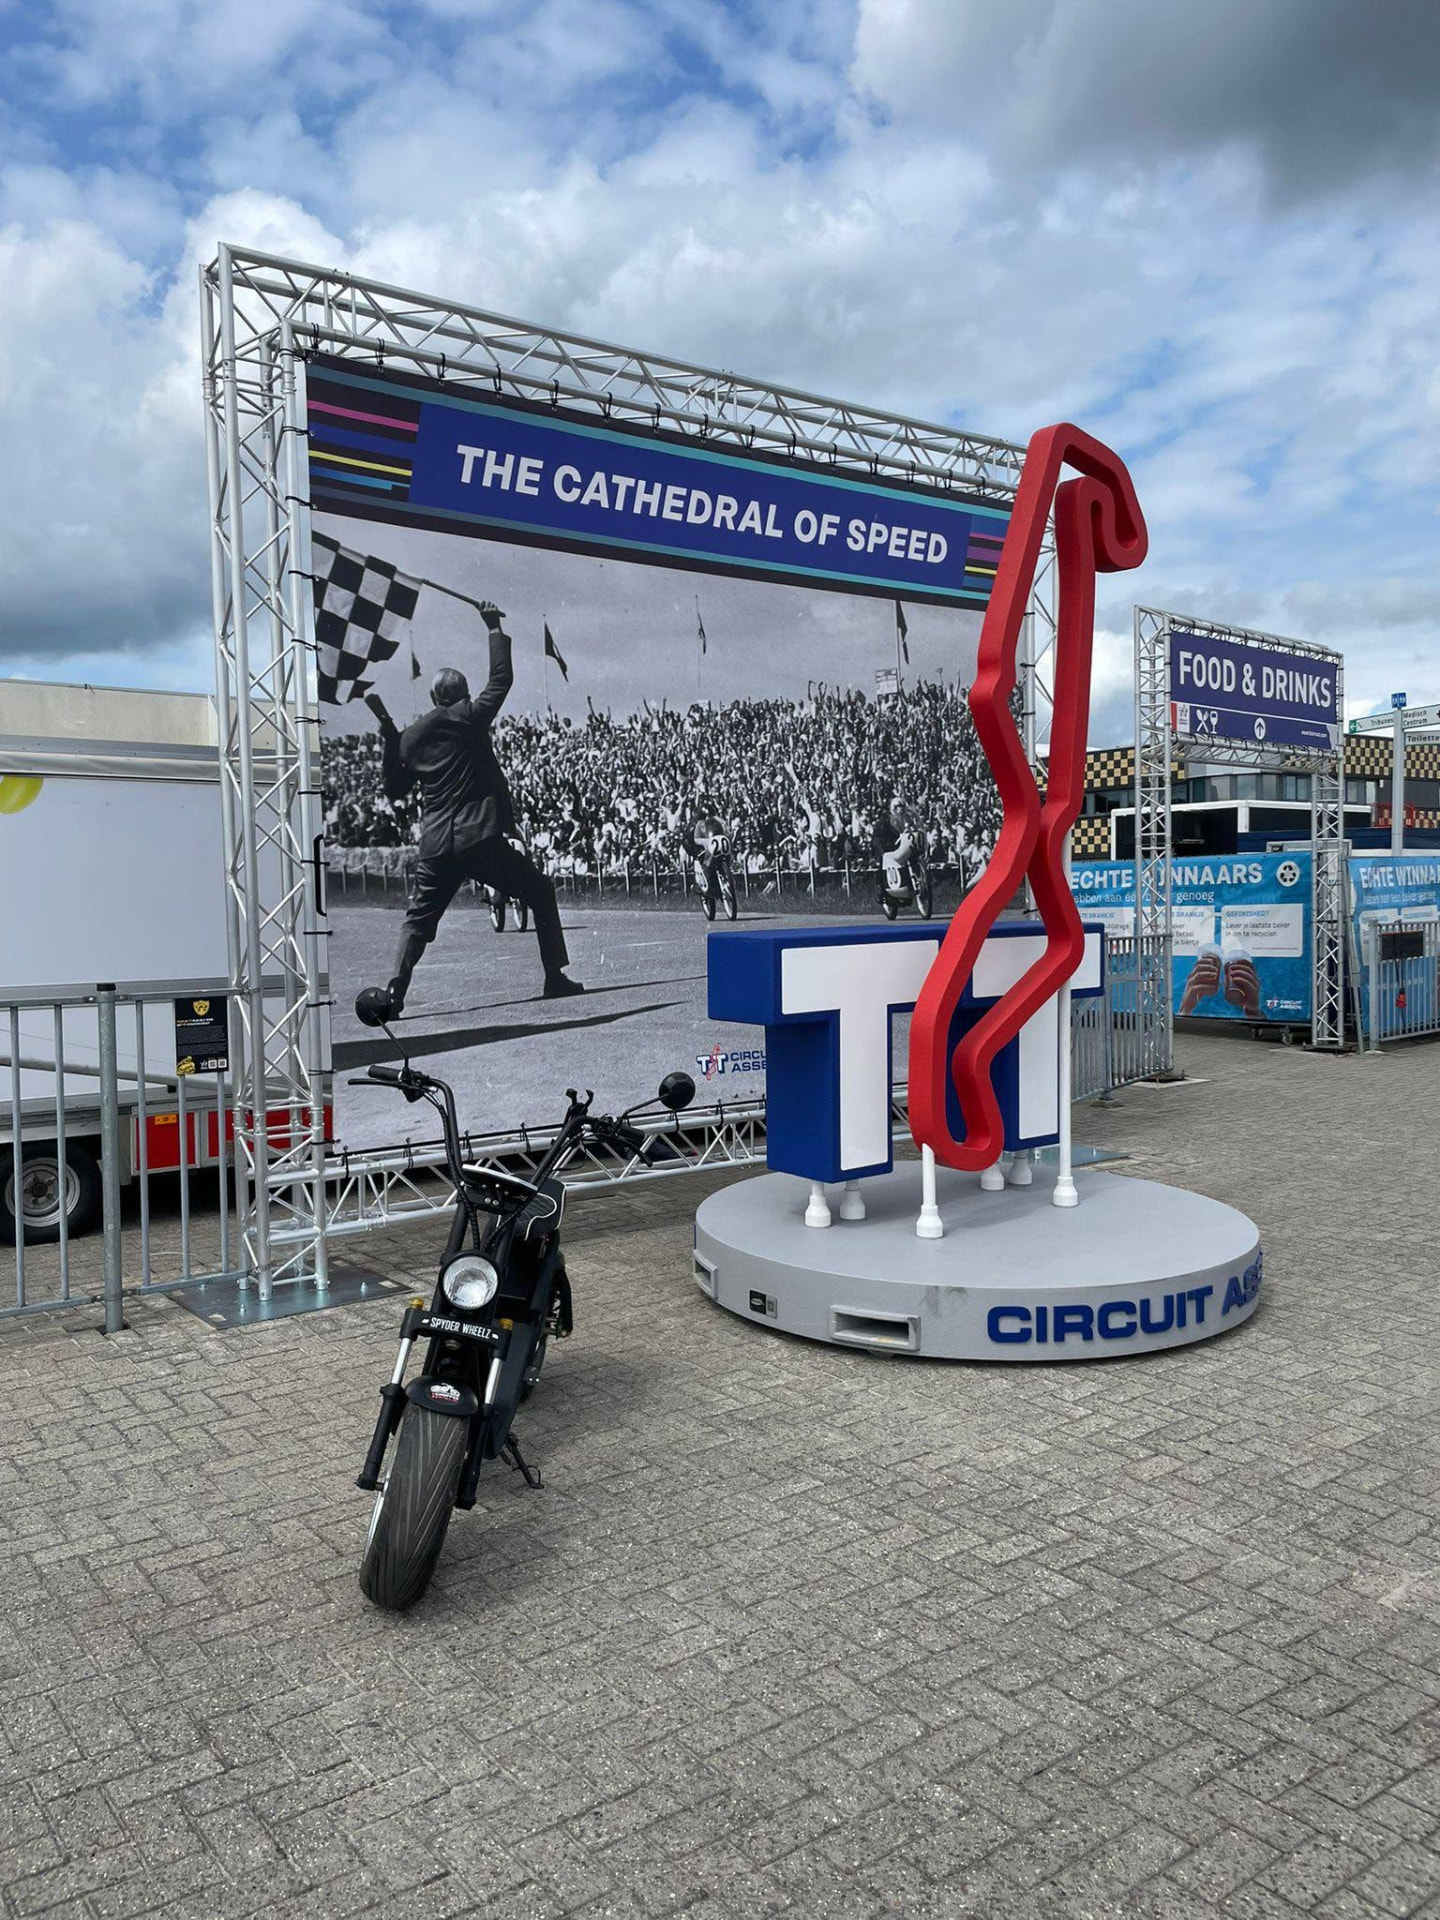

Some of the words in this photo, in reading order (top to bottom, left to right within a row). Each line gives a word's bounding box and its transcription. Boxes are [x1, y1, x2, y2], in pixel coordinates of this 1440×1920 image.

[457, 444, 544, 496] THE
[553, 464, 784, 539] CATHEDRAL
[794, 510, 841, 546] OF
[846, 518, 948, 564] SPEED
[1179, 651, 1236, 693] FOOD
[1242, 663, 1256, 697] &
[1262, 666, 1331, 708] DRINKS
[711, 837, 730, 855] 20
[1071, 869, 1133, 890] ECHTE
[1074, 892, 1102, 904] ebben
[1104, 894, 1122, 903] aan
[1176, 890, 1215, 904] genoeg
[986, 1285, 1214, 1344] CIRCUIT
[430, 1317, 461, 1332] SPYDER
[462, 1323, 492, 1339] WHEELZ
